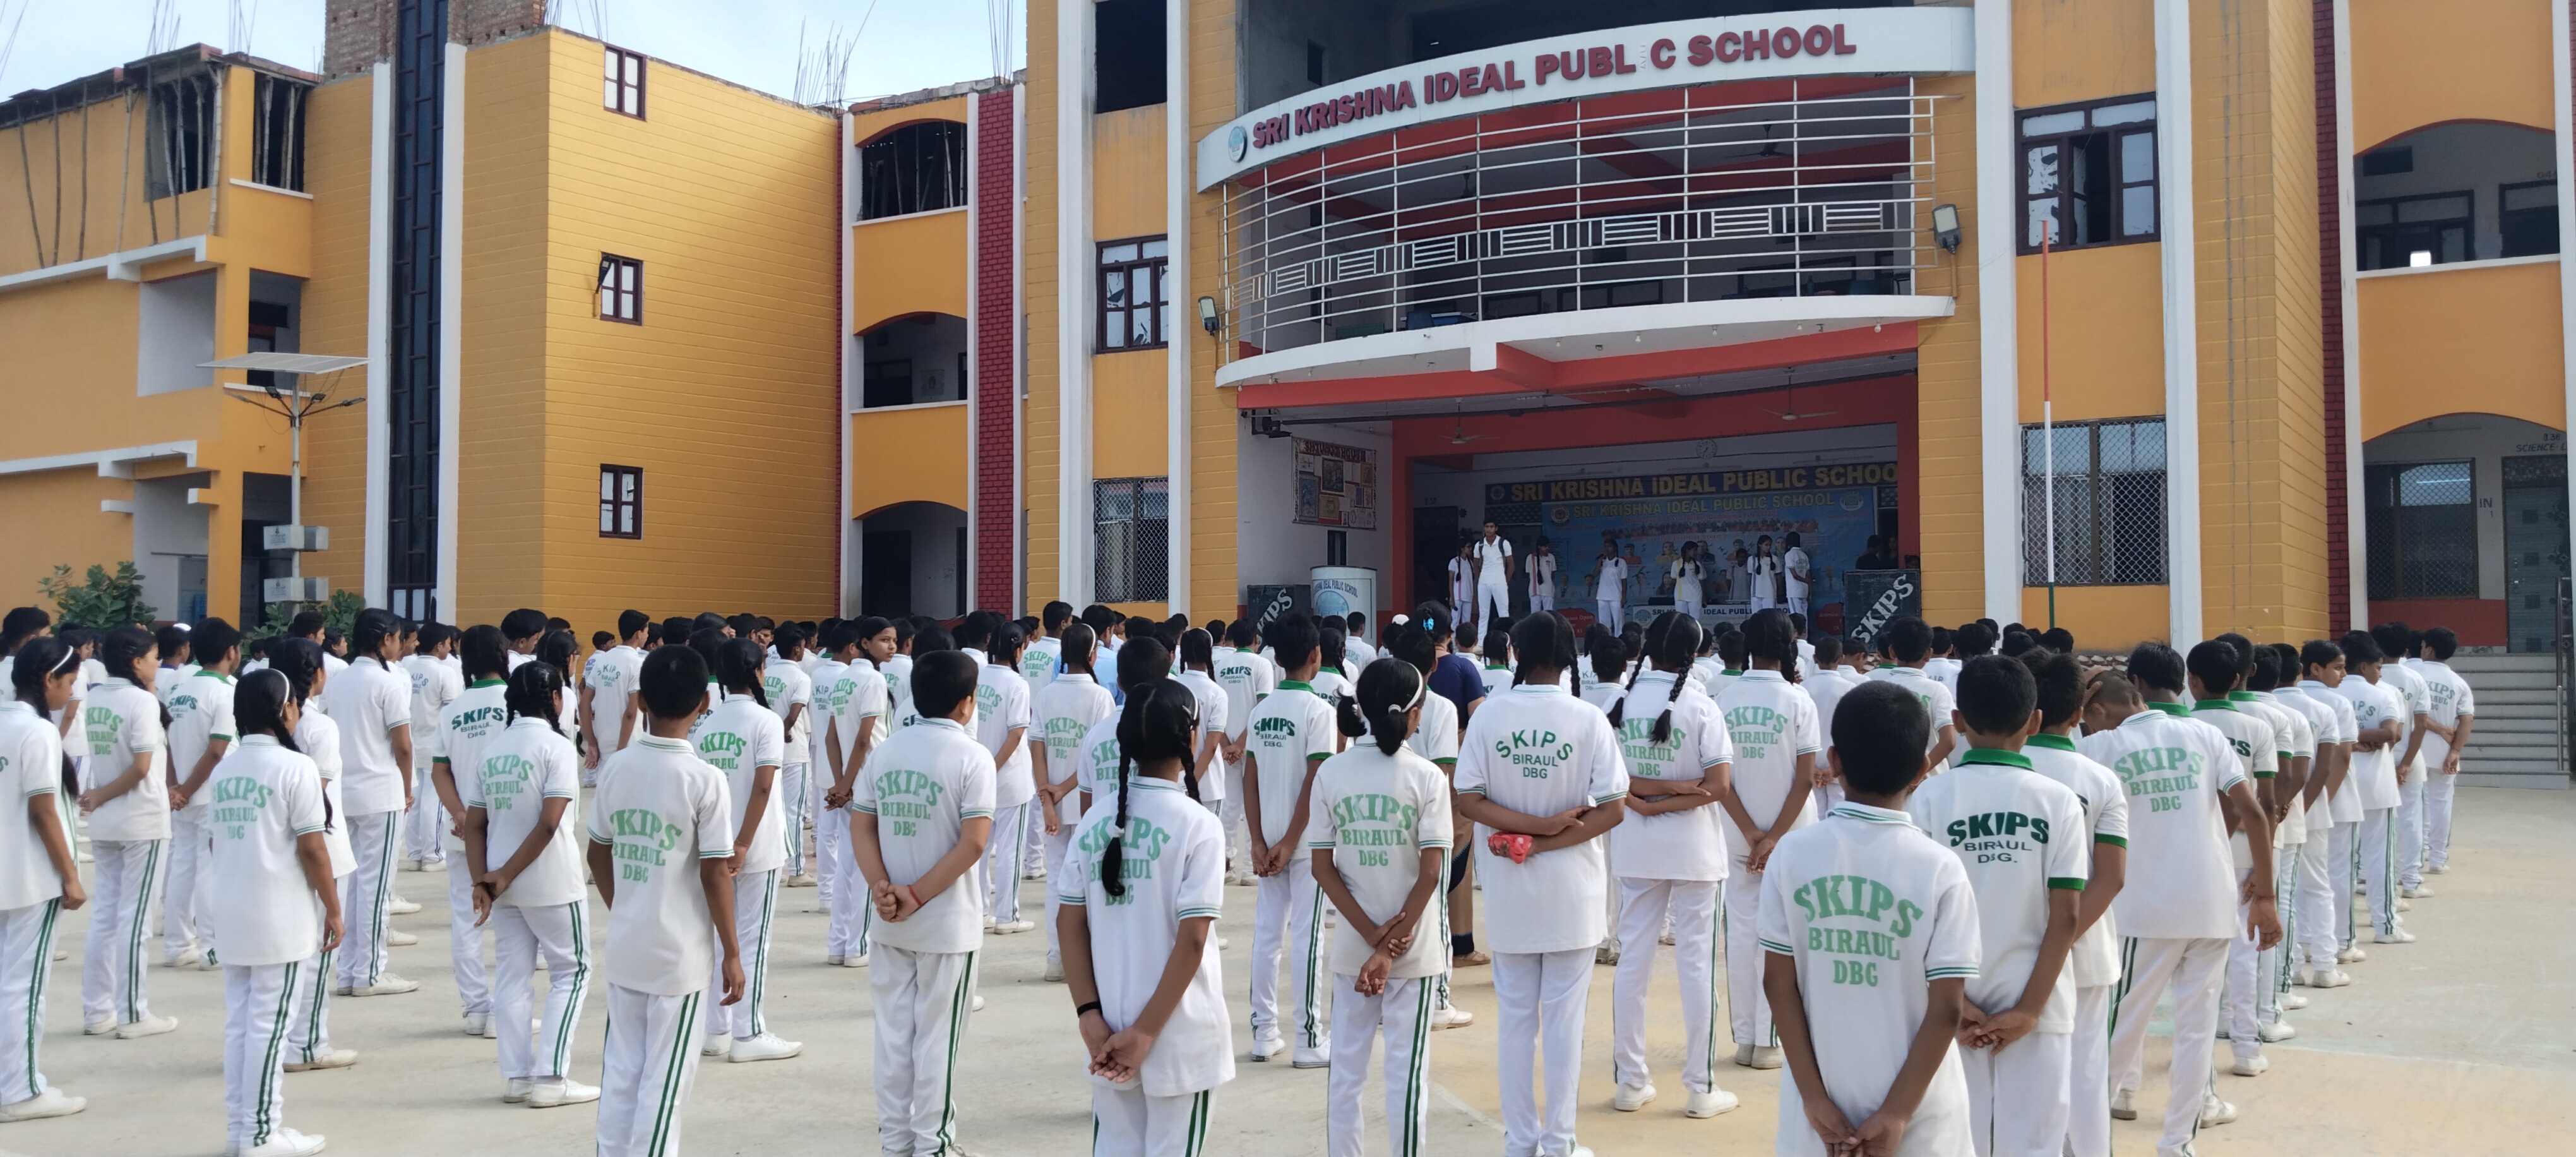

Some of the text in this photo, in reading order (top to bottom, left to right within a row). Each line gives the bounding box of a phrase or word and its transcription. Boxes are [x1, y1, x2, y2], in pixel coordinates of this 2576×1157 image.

[1252, 112, 1290, 149] SRI
[1294, 80, 1417, 136] KRISHNA
[1424, 60, 1525, 104] IDEAL
[1687, 23, 1857, 66] SCHOOL
[1511, 463, 1898, 502] SRI KRISHNA IDEAL PUBLIC SCHOO
[1573, 493, 1835, 518] SRI KRISHNA IDEAL PUBLIC SCHOOL
[2479, 498, 2492, 508] IN
[1851, 573, 1914, 644] SKIPS
[1024, 651, 1054, 666] SKIPS
[1220, 666, 1252, 677] SKIPS
[763, 676, 787, 693] KIPS
[167, 695, 198, 710] SKIPS
[451, 706, 504, 729] SKIPS
[1254, 717, 1295, 736] SKIPS
[1724, 705, 1789, 734] SKIPS
[460, 721, 492, 733] BIRAUL
[1496, 729, 1573, 761] SKIPS
[1731, 731, 1778, 744] BIRAUL
[1513, 753, 1558, 767] BIRAUL
[1625, 744, 1675, 762] BIRAUL
[1742, 746, 1765, 758] DBG
[1523, 767, 1547, 779] DBG
[1637, 762, 1661, 776] DBG
[2114, 746, 2205, 783] SKIPS
[876, 770, 943, 806] SKIPS
[2129, 774, 2198, 796] BIRAUL
[881, 802, 931, 820] BIRAUL
[1333, 793, 1417, 830] SKIPS
[2150, 795, 2181, 812] DBG
[893, 822, 916, 837] DBG
[1341, 829, 1407, 846] BIRAUL
[1947, 812, 2049, 847] SKIPS
[1964, 841, 2032, 852] BIRAUL
[1359, 849, 1389, 866] DBG
[623, 863, 649, 884] DBG
[1793, 875, 1924, 938] SKIPS
[1808, 926, 1900, 961] BIRAUL
[1834, 959, 1878, 987] DBG
